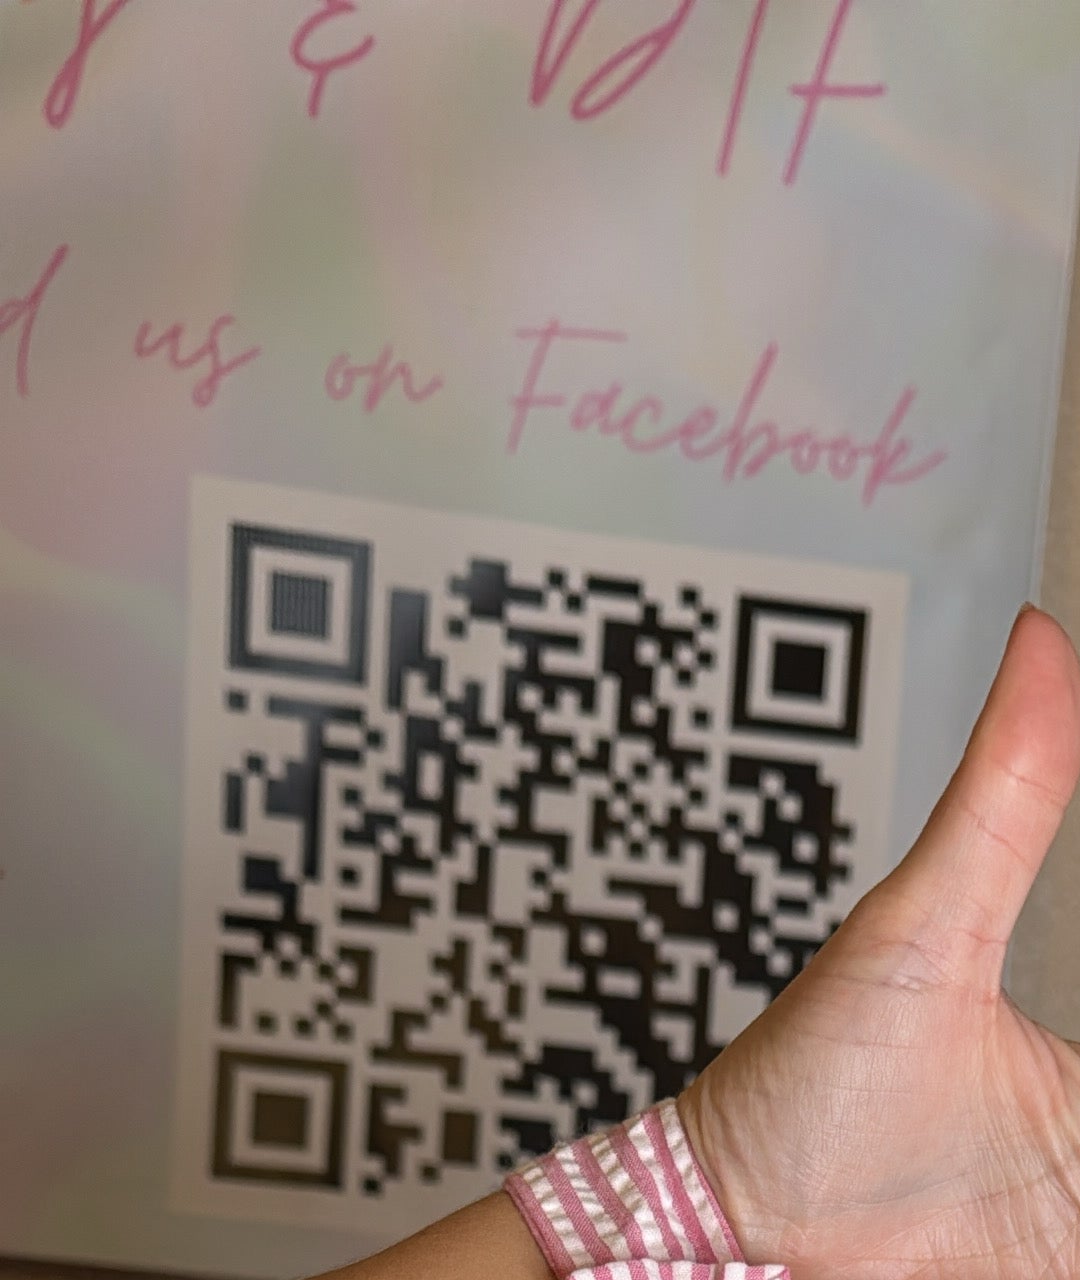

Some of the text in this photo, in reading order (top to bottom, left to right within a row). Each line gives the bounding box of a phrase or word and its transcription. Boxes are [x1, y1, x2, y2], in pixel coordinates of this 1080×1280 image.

[134, 314, 262, 408] us
[324, 344, 445, 413] on
[504, 317, 950, 507] Facebook
